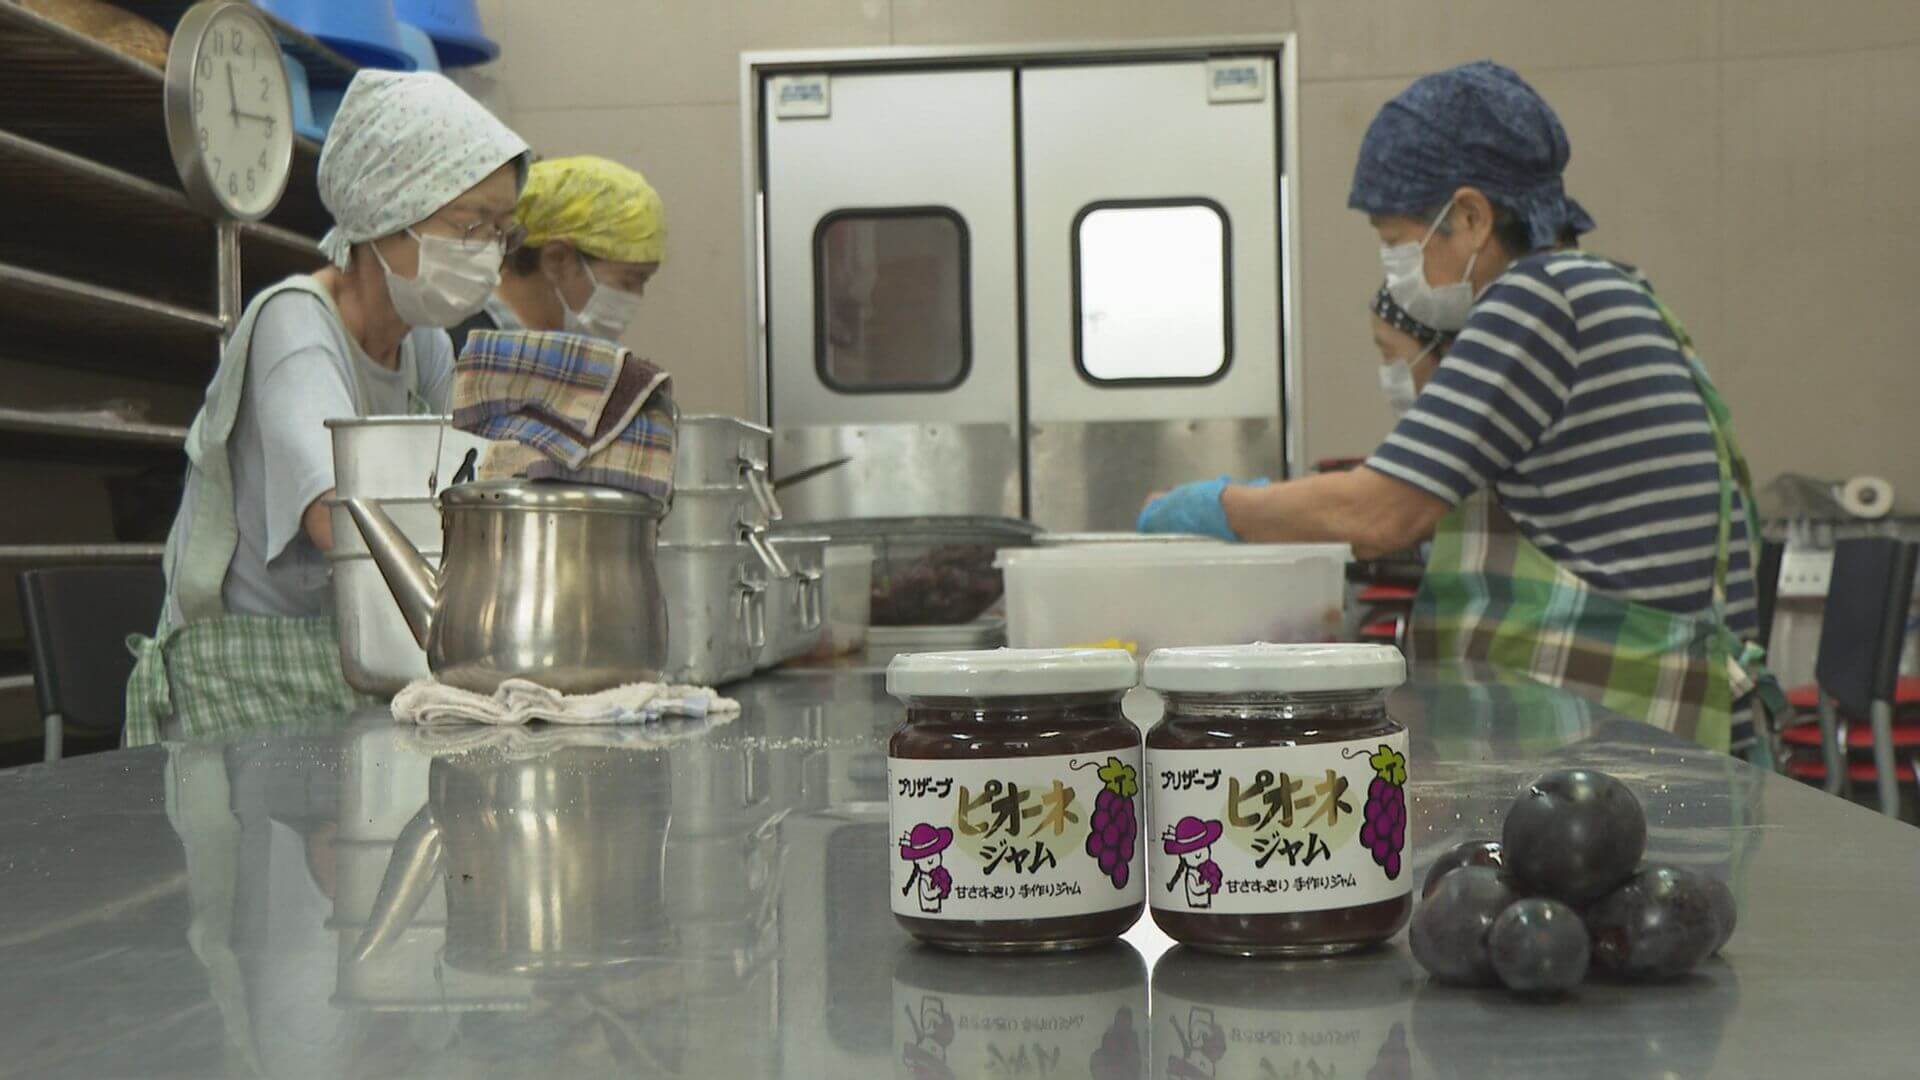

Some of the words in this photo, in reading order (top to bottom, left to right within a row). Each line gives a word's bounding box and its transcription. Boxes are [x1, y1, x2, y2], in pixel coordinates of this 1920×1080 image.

[214, 30, 224, 56] 11
[231, 29, 243, 56] 12
[259, 76, 270, 102] 2
[213, 156, 222, 182] 7
[257, 150, 268, 173] 4
[228, 172, 239, 196] 6
[246, 169, 256, 192] 5
[898, 776, 954, 799] プリザーブ
[1161, 768, 1222, 790] プリザーブ
[958, 779, 1080, 839] ピオーネ
[1228, 769, 1353, 832] ピオーネ
[979, 839, 1057, 875] ジャム
[1251, 831, 1331, 868] ジャム
[1019, 880, 1083, 899] 手作りジャム
[1294, 872, 1357, 892] 手作りジャム
